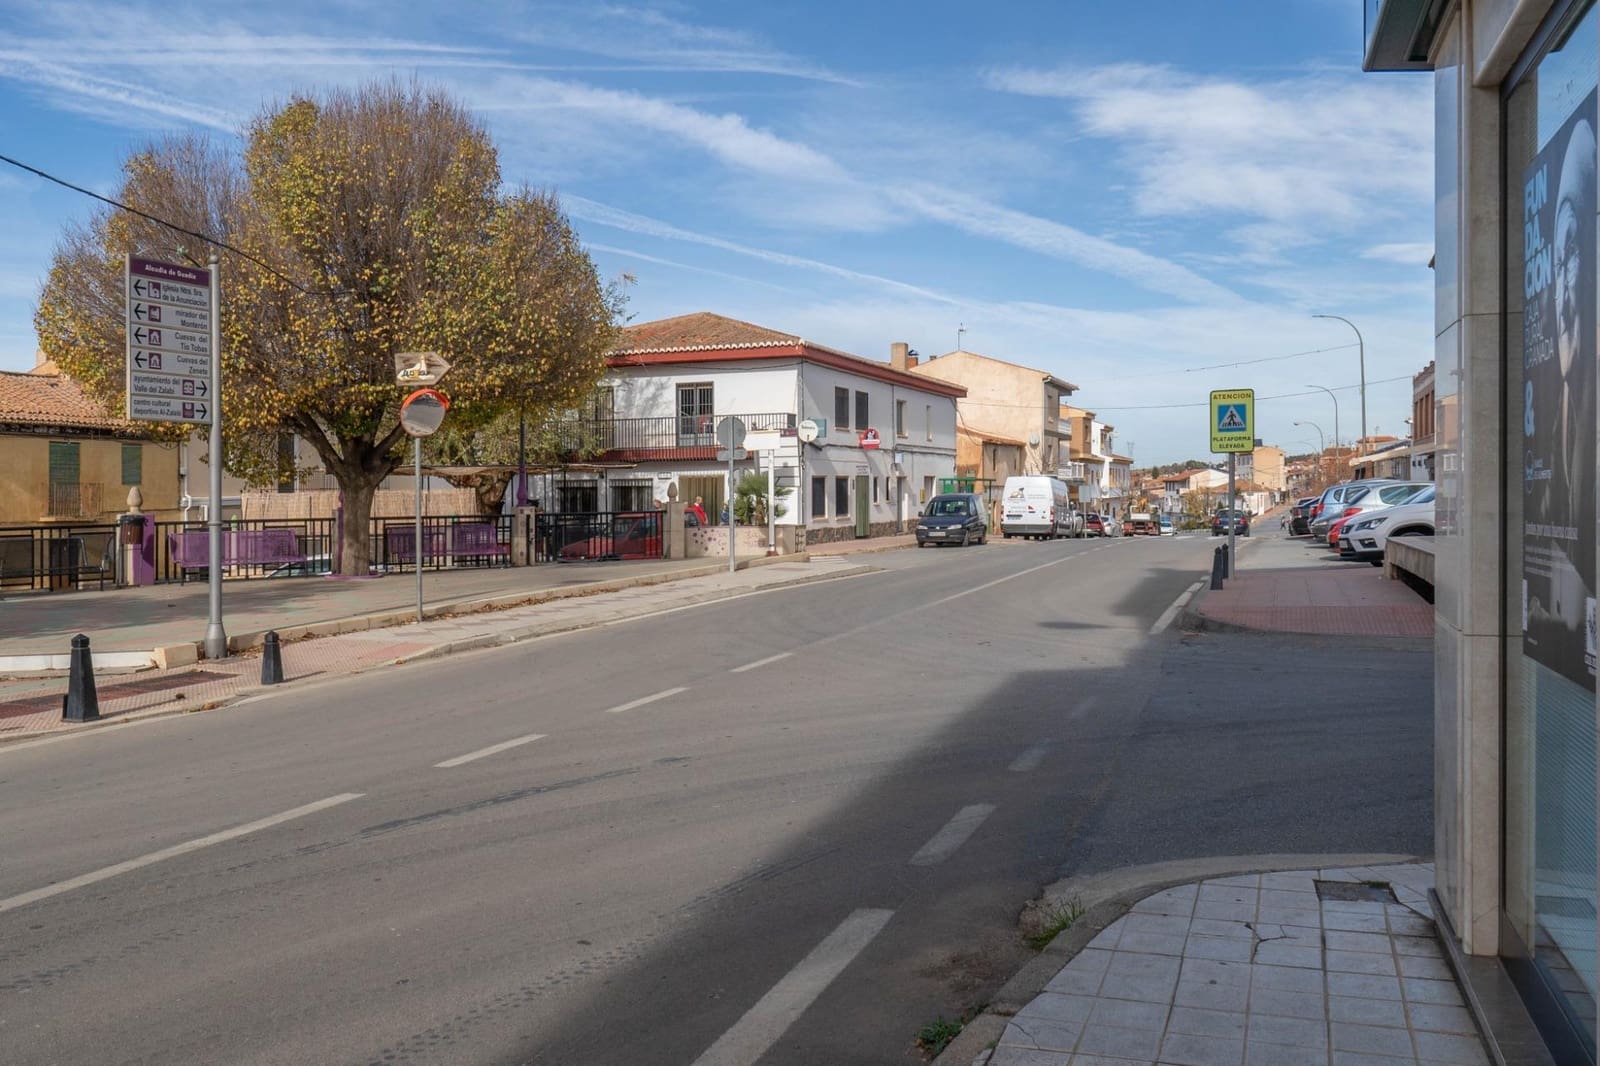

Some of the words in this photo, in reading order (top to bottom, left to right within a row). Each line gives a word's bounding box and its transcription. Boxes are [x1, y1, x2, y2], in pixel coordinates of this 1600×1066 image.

[1525, 164, 1547, 221] FUN
[168, 268, 176, 276] de
[198, 312, 208, 320] del
[174, 332, 196, 342] Cuevas
[198, 335, 208, 343] del
[176, 355, 198, 365] Cuevas
[198, 358, 208, 366] del
[134, 384, 148, 393] Valle
